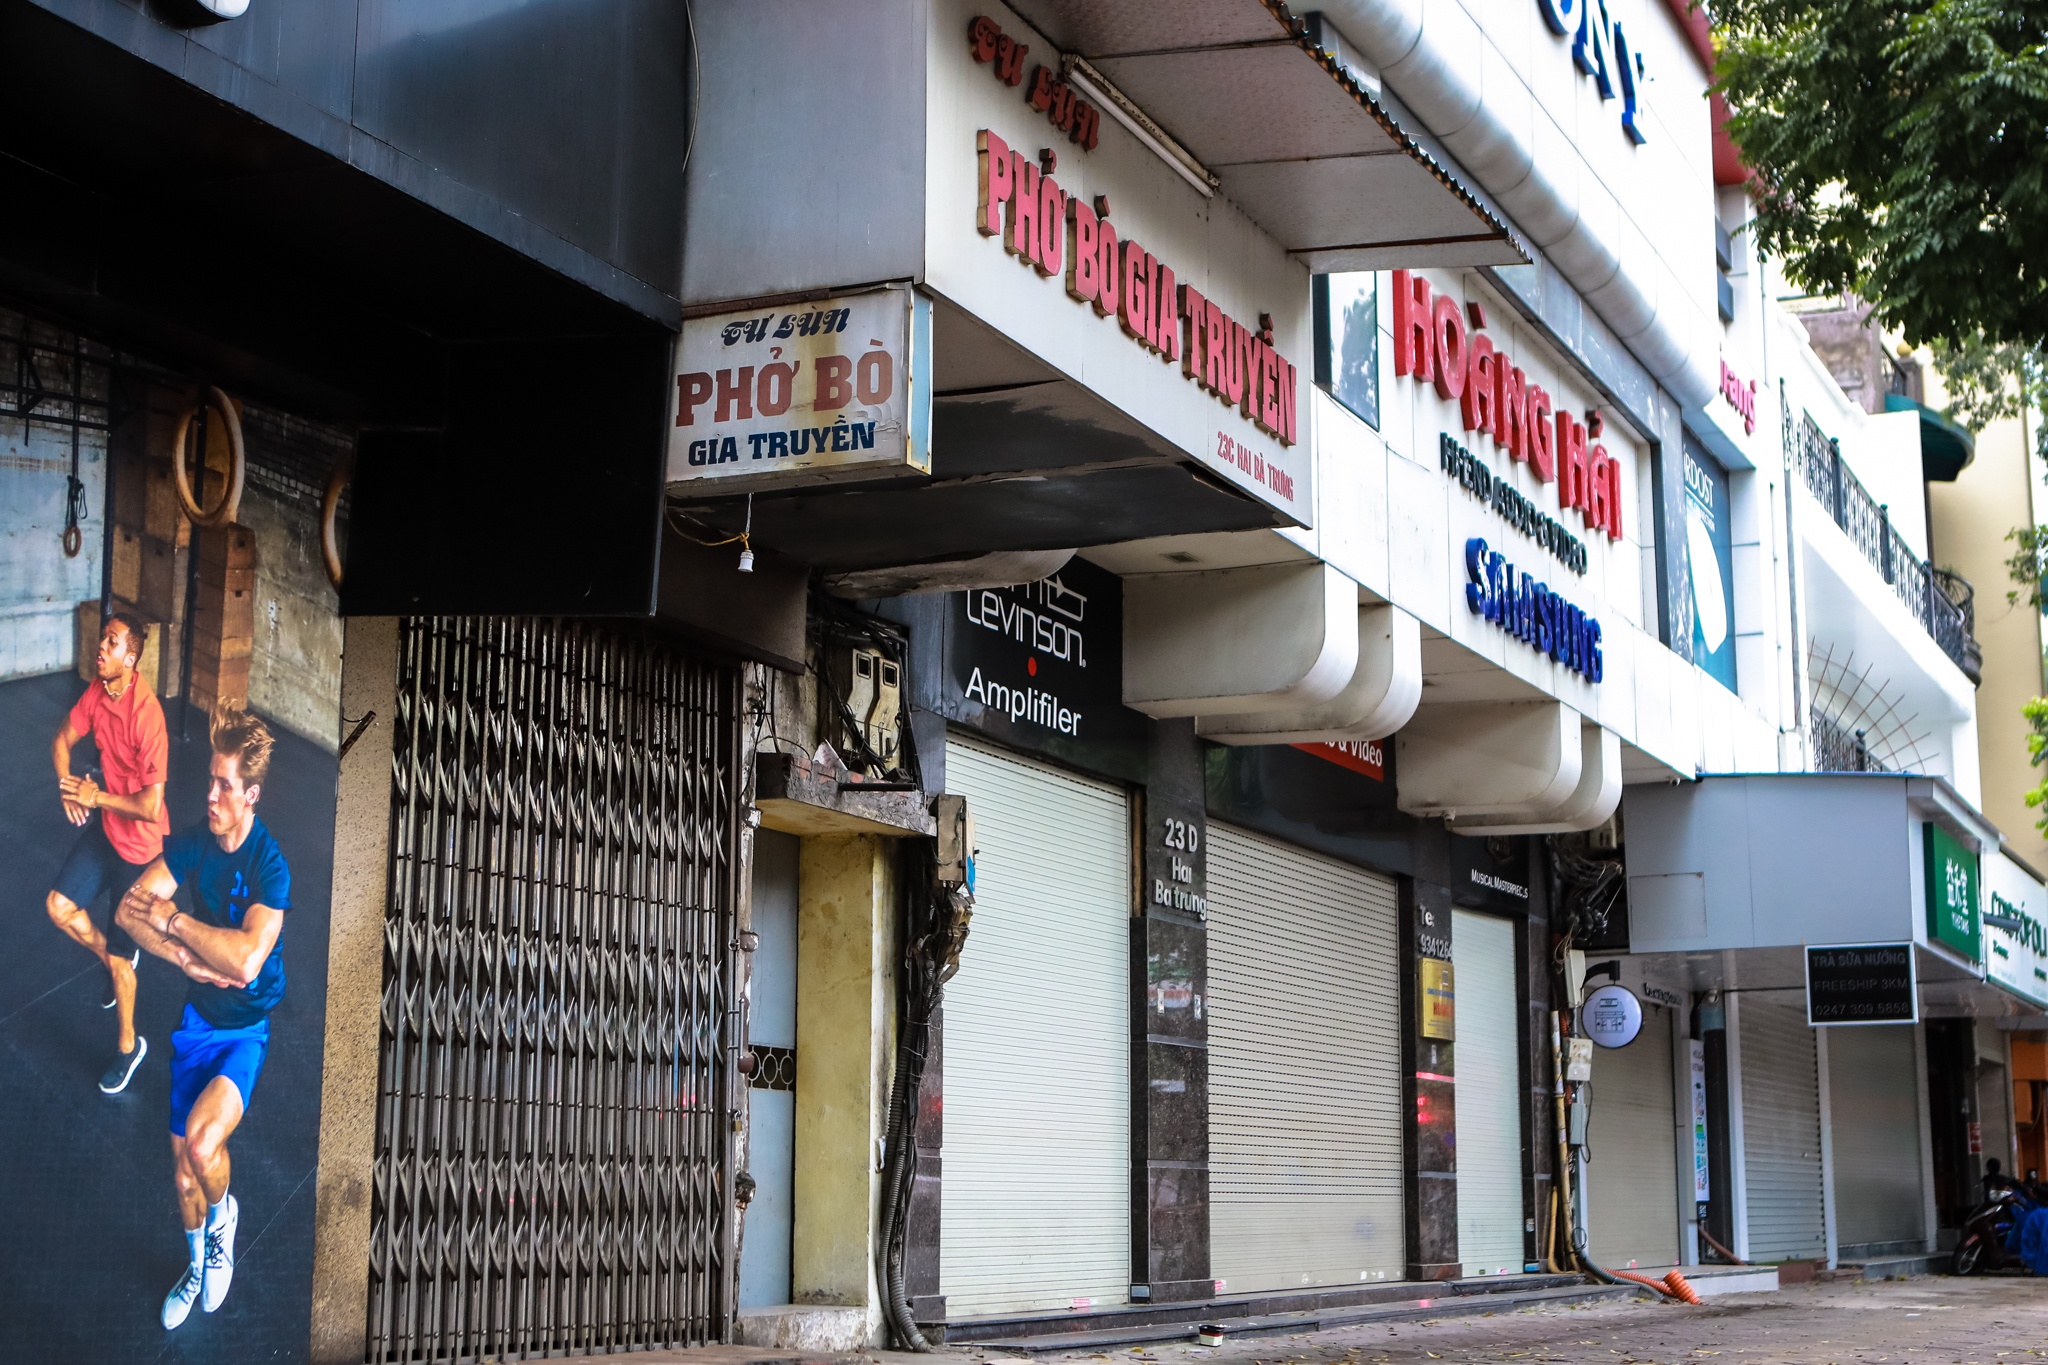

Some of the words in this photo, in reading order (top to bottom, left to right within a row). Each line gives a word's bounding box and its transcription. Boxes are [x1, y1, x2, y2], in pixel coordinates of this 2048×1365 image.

[977, 129, 1067, 277] PHỞ
[1066, 195, 1119, 317] BÒ
[1118, 239, 1179, 363] GIA
[1177, 283, 1297, 446] TRUYỀN
[675, 346, 800, 428] PHỞ
[813, 338, 894, 412] BÒ
[1392, 268, 1555, 482] HOÀNG
[1556, 409, 1623, 542] HẢI
[688, 436, 739, 467] GIA
[747, 414, 876, 461] TRUYỀN
[1217, 430, 1235, 464] 23C
[1237, 442, 1252, 476] HAI
[1254, 451, 1265, 485] BÀ
[1683, 452, 1714, 508] RDOST
[1491, 476, 1537, 537] AUDIO
[1536, 511, 1549, 547] &
[1546, 517, 1588, 575] VIDEO
[964, 666, 1082, 737] Amplifiler
[1165, 817, 1185, 850] 23
[1188, 823, 1198, 853] D
[1155, 878, 1172, 907] Ba
[1172, 855, 1192, 884] Hai
[1814, 979, 1877, 991] FREESHIP
[1881, 978, 1908, 990] 3KM
